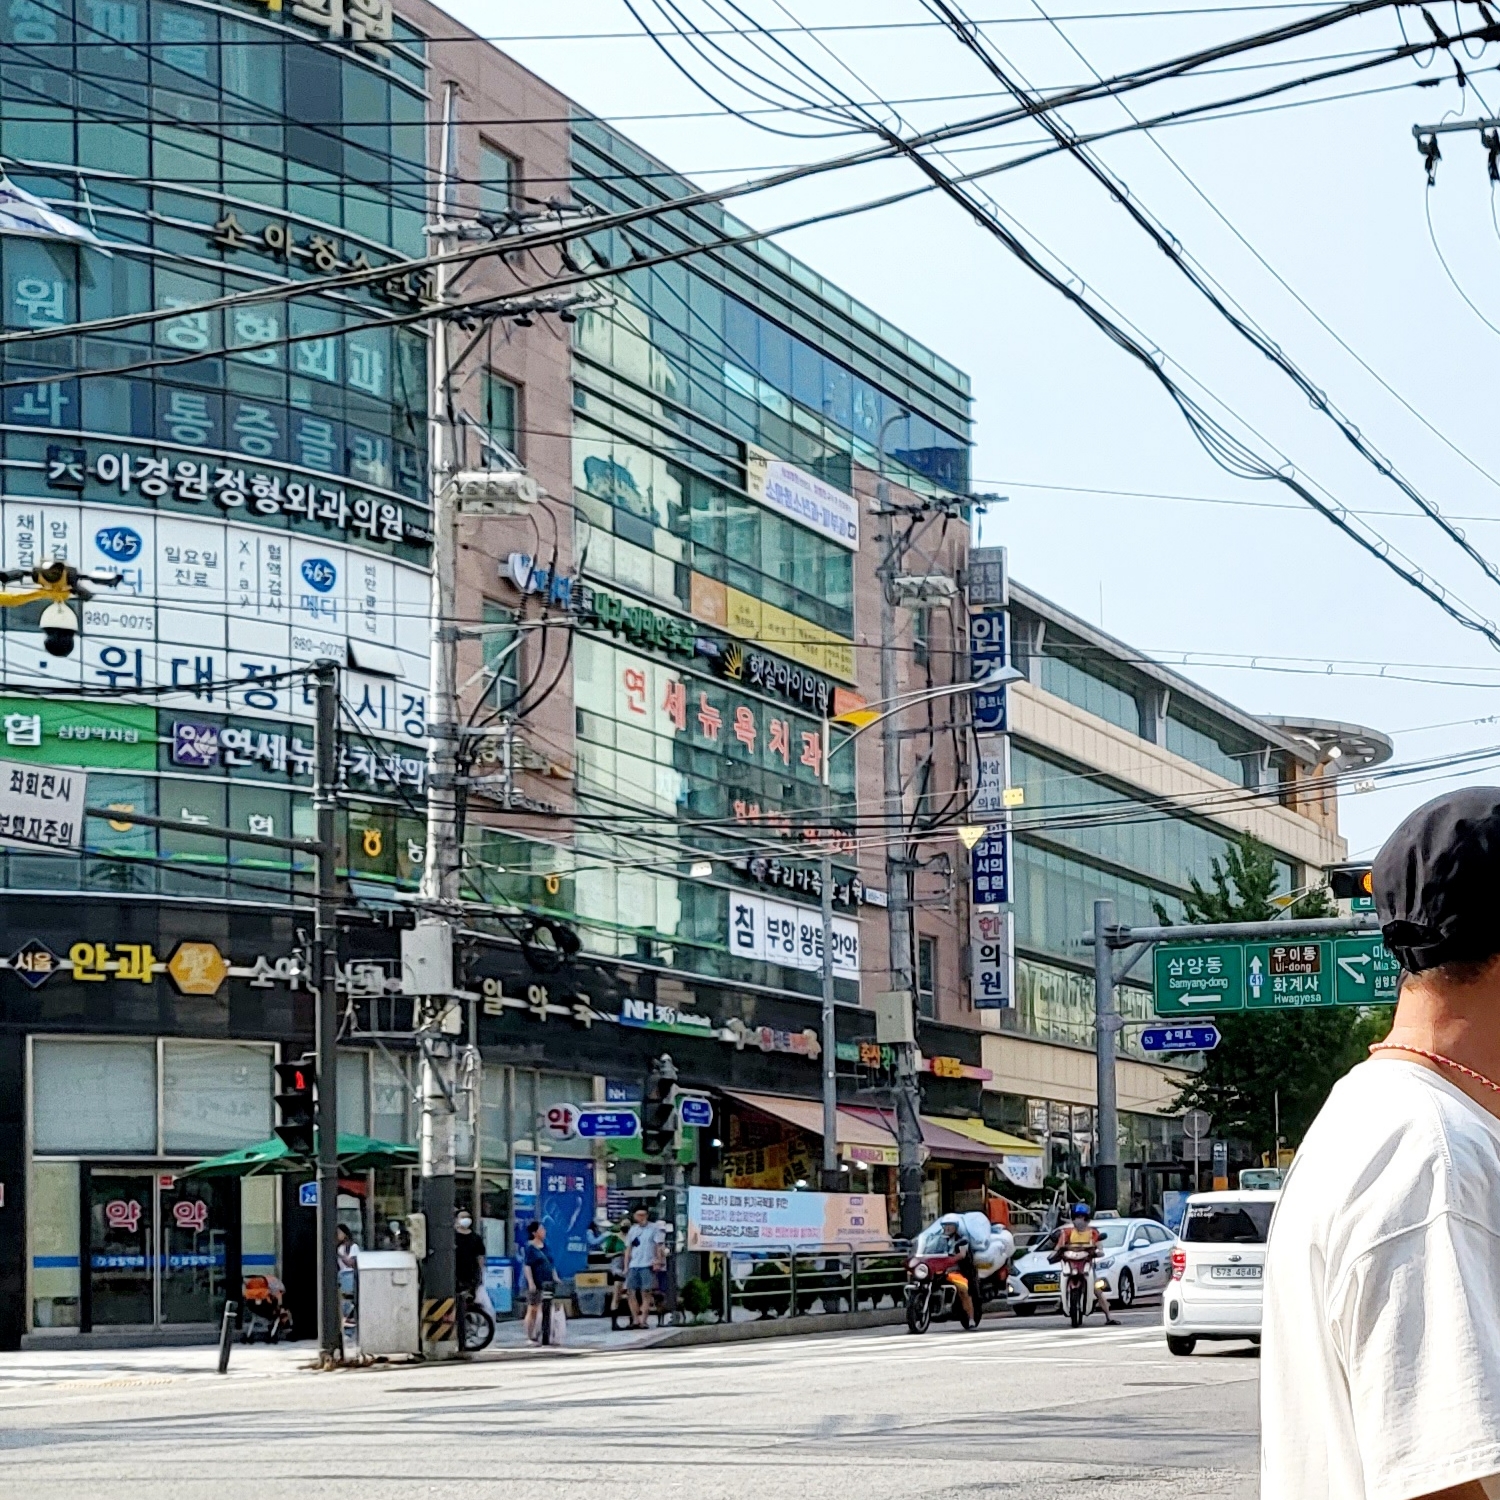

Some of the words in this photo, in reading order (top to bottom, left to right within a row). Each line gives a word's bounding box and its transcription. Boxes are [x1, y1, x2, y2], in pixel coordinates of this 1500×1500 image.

[96, 453, 404, 542] 이경원정형외과의원
[97, 531, 139, 556] 365
[164, 546, 218, 569] 일요일
[174, 568, 208, 587] 진료
[750, 654, 829, 713] 햇살아이의원
[624, 668, 822, 777] 연세뉴욕치과
[9, 769, 73, 802] 좌회전시
[734, 903, 755, 950] 침
[766, 916, 796, 953] 부항
[69, 942, 156, 984] 안과
[978, 916, 1003, 996] 한의원
[1167, 956, 1223, 976] 삼양동
[1272, 946, 1317, 963] 우이동
[1373, 960, 1389, 971] Mia
[1275, 962, 1312, 973] Ui-dong
[1169, 977, 1228, 990] Samyang-dong
[1272, 975, 1319, 993] 화계사
[624, 998, 654, 1021] NH
[1274, 993, 1322, 1006] Hwagyesa
[1204, 1033, 1214, 1042] 57
[548, 1108, 574, 1135] 약
[106, 1200, 141, 1233] 약
[173, 1200, 208, 1233] 약
